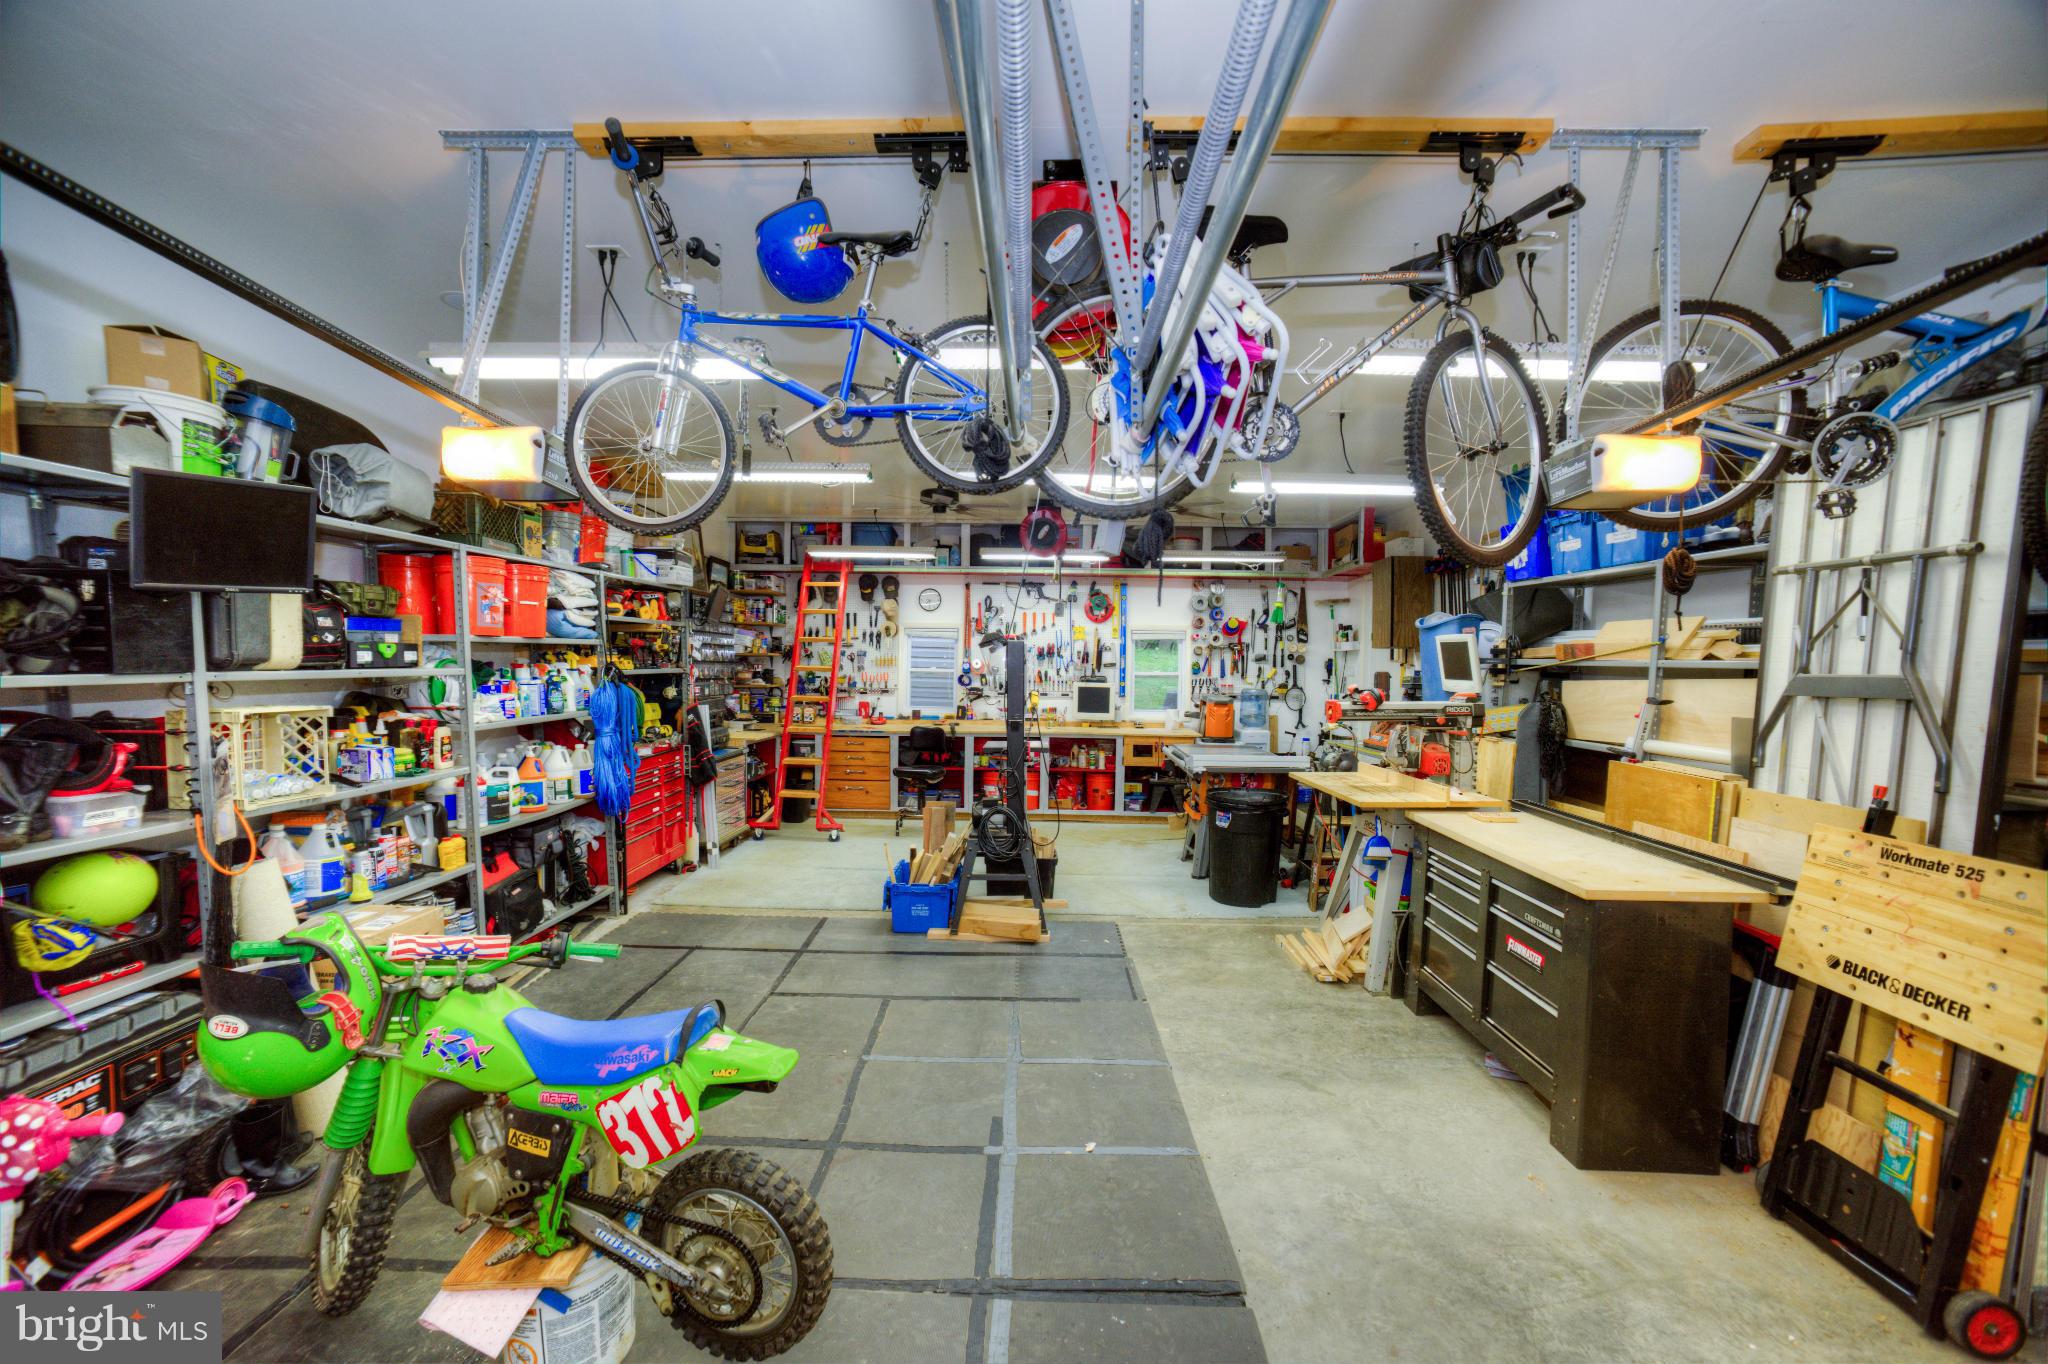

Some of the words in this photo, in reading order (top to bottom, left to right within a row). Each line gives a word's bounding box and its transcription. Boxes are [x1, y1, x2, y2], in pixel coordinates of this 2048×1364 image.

[1880, 847, 1950, 873] Workmate
[1955, 865, 1986, 882] 525
[1524, 913, 1554, 934] CRAFTSMAN
[1843, 959, 1888, 989] BLACK
[1889, 978, 1901, 994] &
[1902, 983, 1971, 1022] DECKER
[214, 1023, 239, 1034] BELL
[598, 1075, 695, 1169] 372
